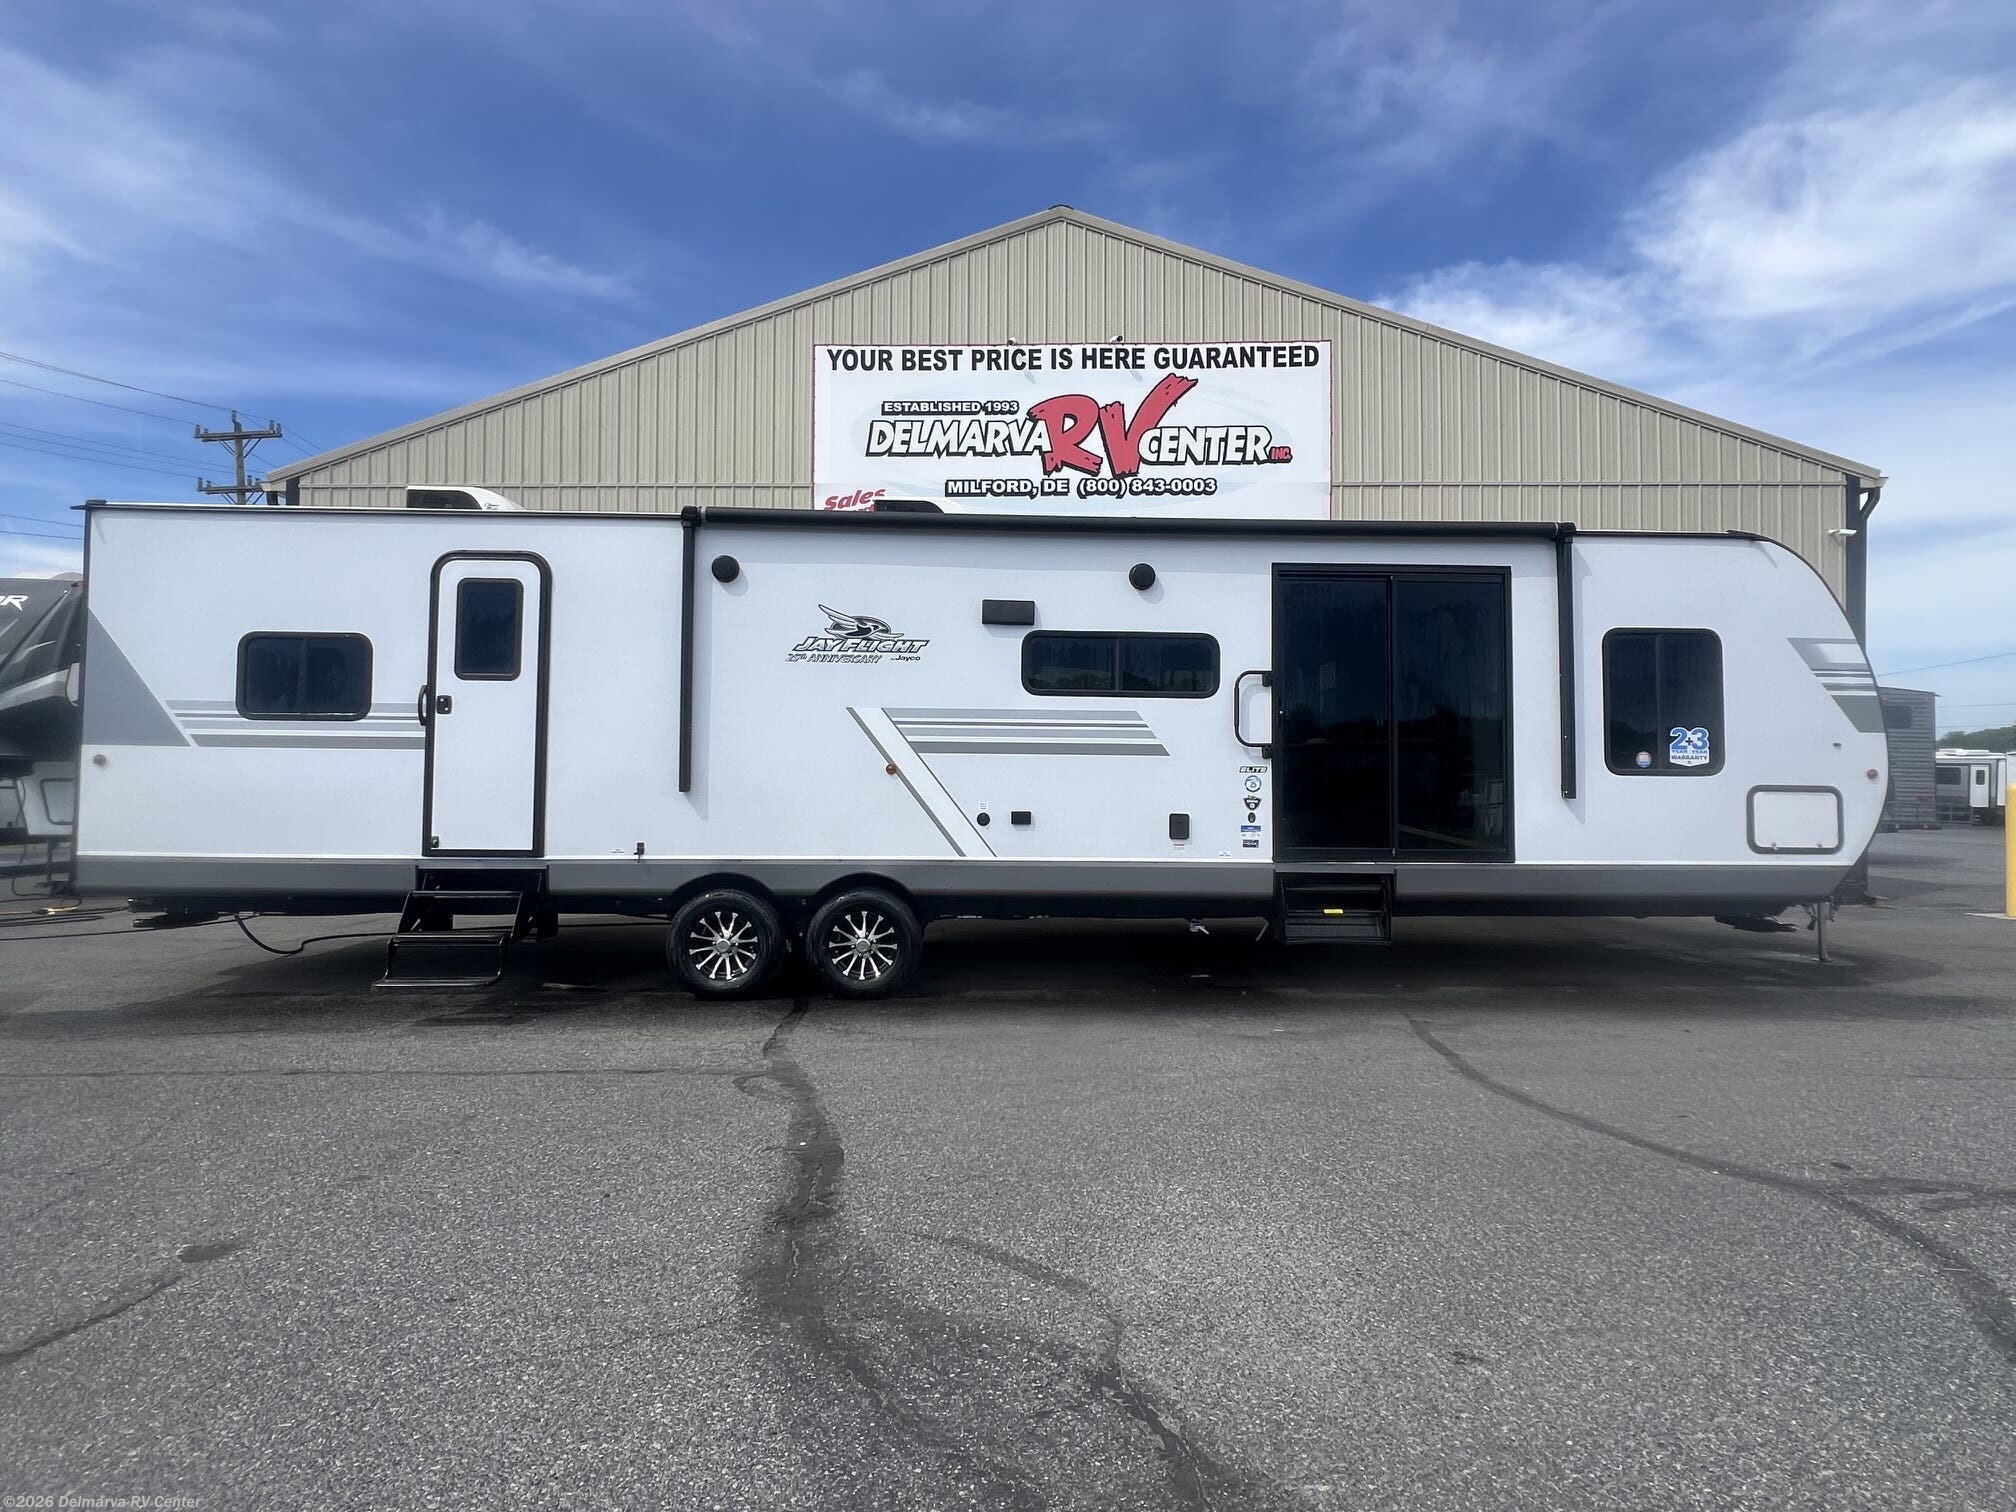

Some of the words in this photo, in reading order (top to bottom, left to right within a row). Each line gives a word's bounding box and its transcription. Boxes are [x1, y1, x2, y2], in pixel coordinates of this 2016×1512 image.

[827, 349, 893, 371] YOUR
[901, 349, 963, 371] BEST
[971, 348, 1042, 371] PRICE
[1050, 348, 1073, 370] IS
[1081, 348, 1145, 369] HERE
[1153, 345, 1320, 369] GUARANTEED
[882, 401, 982, 415] ESTABLISHED
[984, 400, 1019, 414] 1993
[866, 419, 1052, 458] DELMARVA
[1027, 373, 1198, 478] RV
[1138, 426, 1272, 465] CENTER
[945, 480, 1039, 497] MILFORD,
[1041, 479, 1069, 496] DE
[1077, 479, 1127, 498] (800)
[1129, 478, 1217, 496] 843-0003
